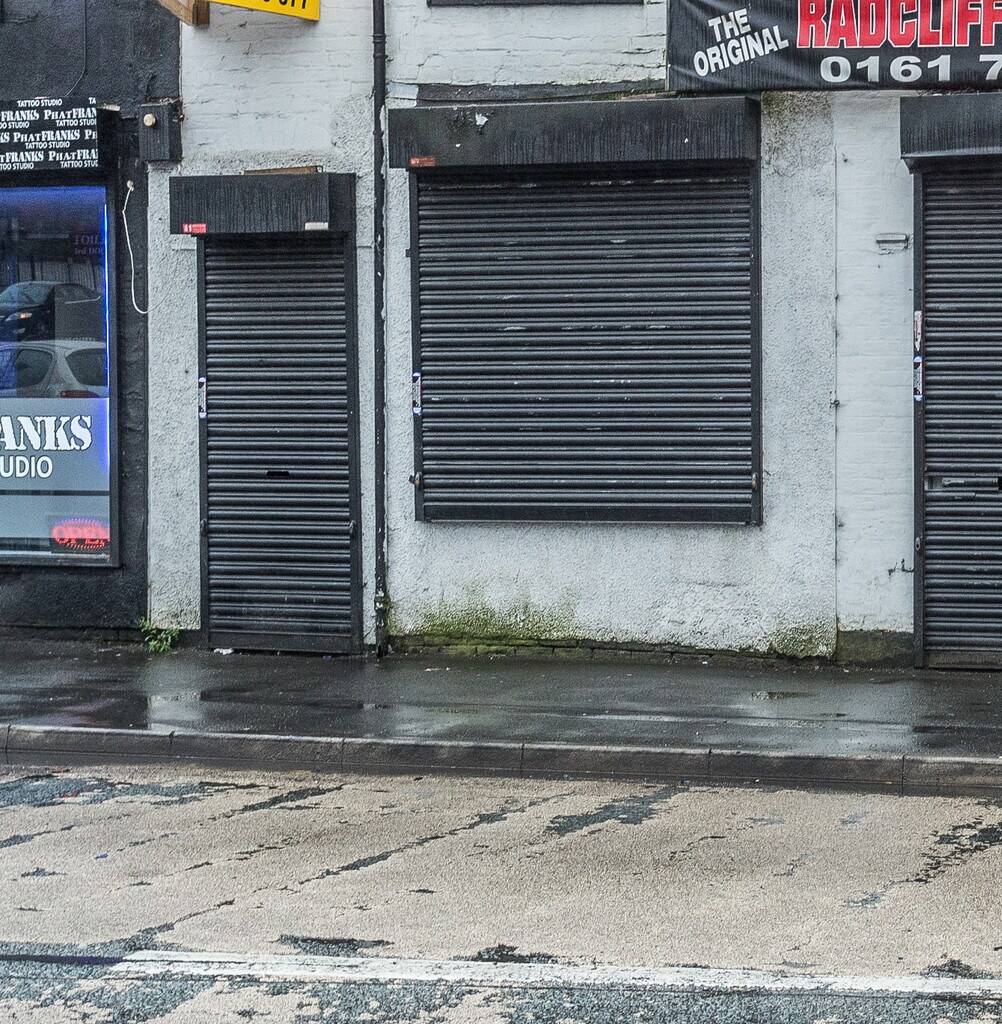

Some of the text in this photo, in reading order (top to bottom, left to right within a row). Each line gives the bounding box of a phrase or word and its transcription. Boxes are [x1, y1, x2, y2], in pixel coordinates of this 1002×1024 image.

[708, 8, 751, 42] THE
[693, 25, 789, 77] ORIGINAL
[820, 55, 952, 83] 0161
[8, 121, 29, 129] STUDIO
[55, 119, 78, 127] TATTOO
[13, 162, 34, 170] STUDIO
[60, 160, 83, 168] TATTOO
